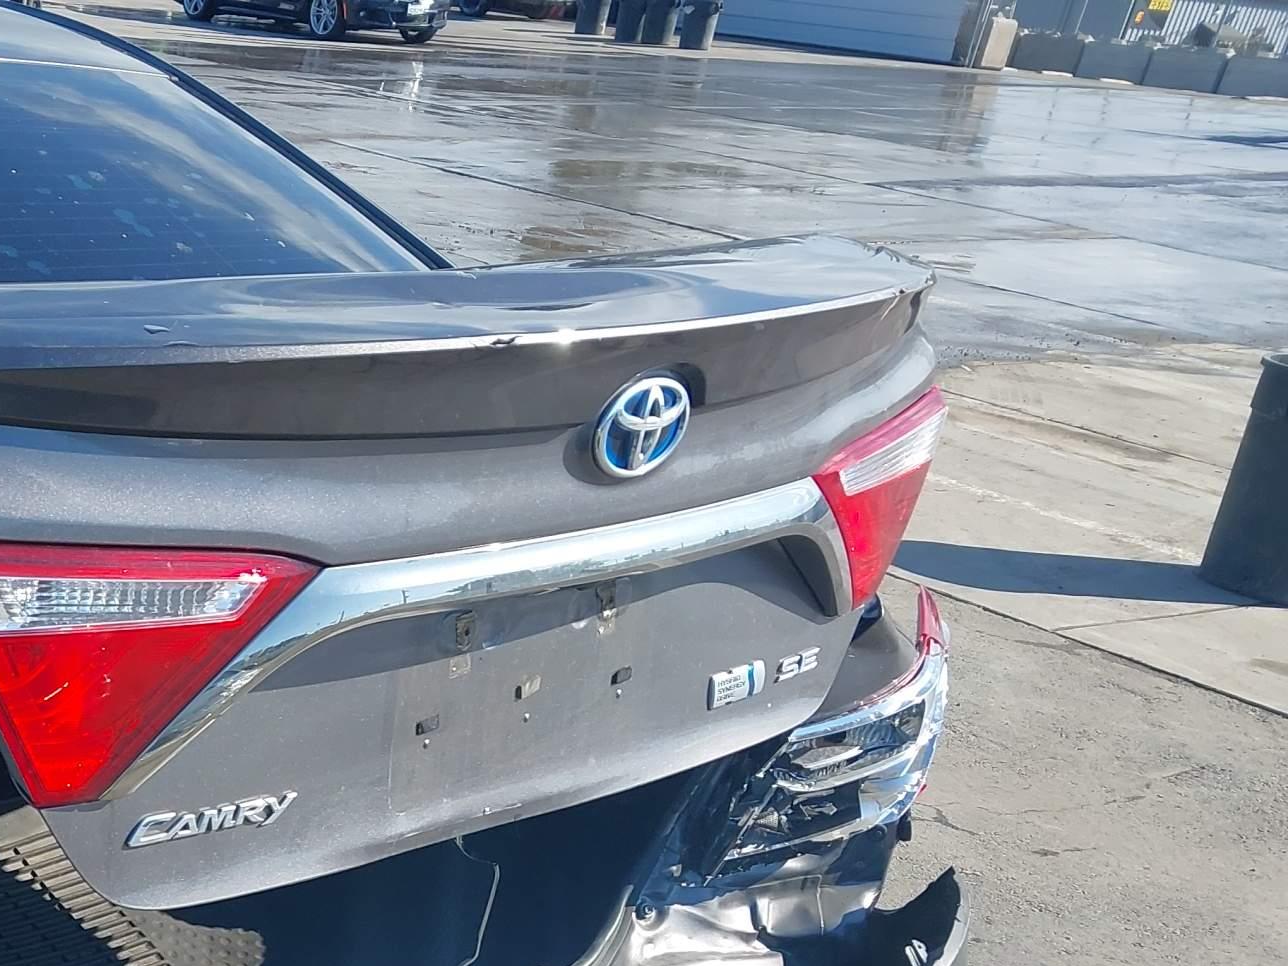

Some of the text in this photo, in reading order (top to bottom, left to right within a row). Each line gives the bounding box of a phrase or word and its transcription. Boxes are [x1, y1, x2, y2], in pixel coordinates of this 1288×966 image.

[775, 646, 822, 683] SE
[717, 680, 746, 694] SYNERGY
[125, 790, 298, 849] CAMRY
